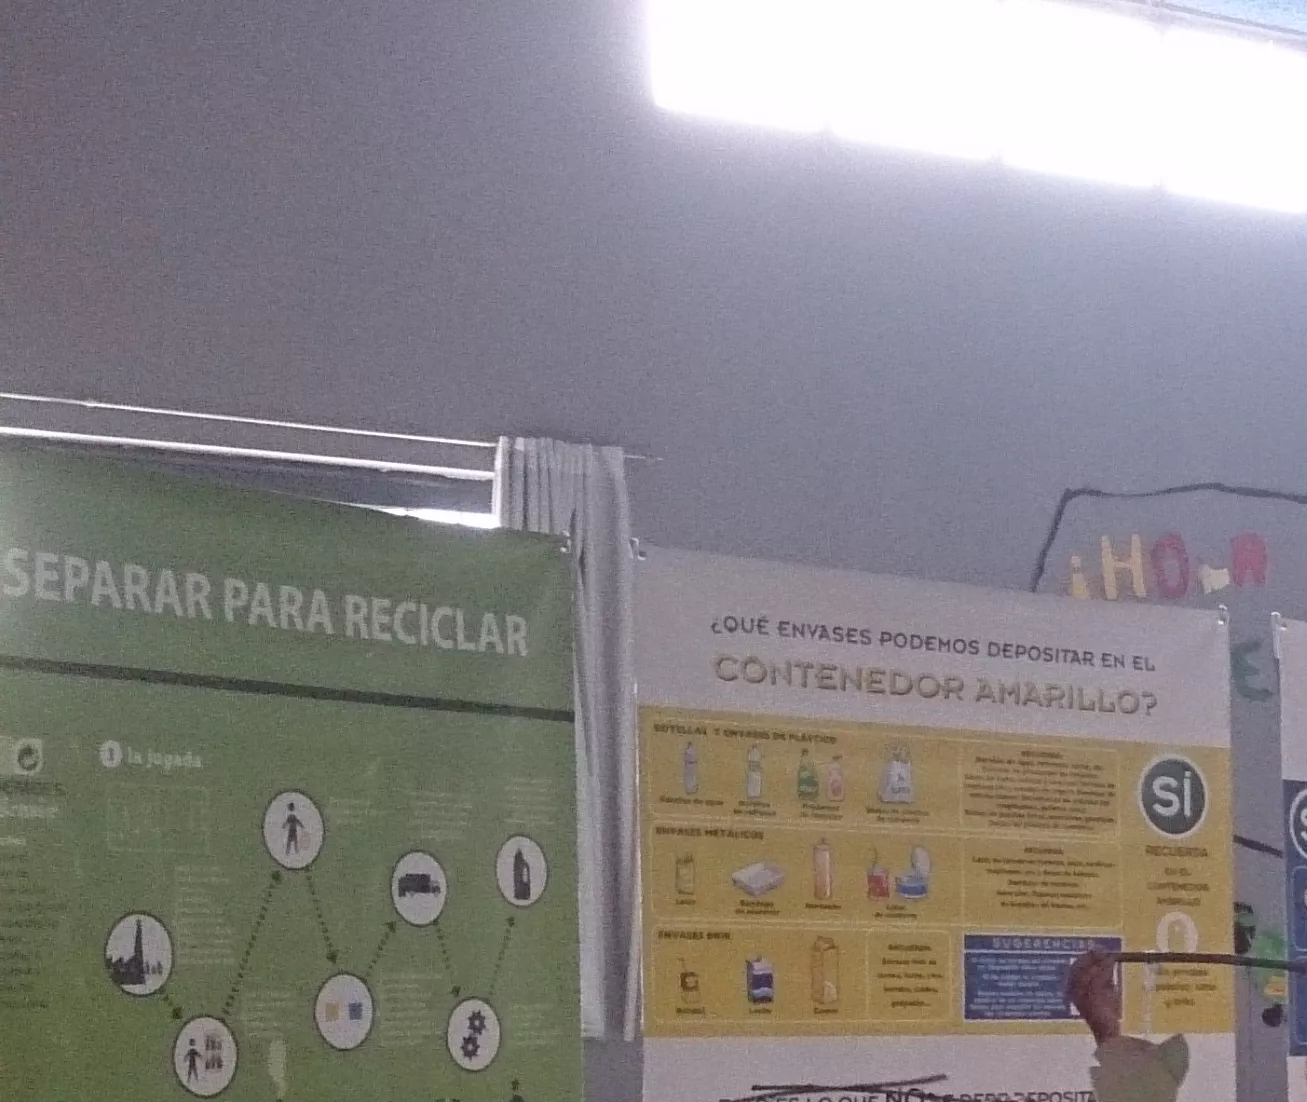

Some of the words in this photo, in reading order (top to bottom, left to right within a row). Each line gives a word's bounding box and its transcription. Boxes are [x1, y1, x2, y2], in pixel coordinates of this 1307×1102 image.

[2, 547, 212, 619] SEPARAR
[223, 578, 335, 636] PARA
[345, 596, 528, 657] RECICLAR
[710, 614, 770, 637] ¿QUÉ
[777, 620, 872, 646] ENVASES
[879, 631, 980, 656] PODEMOS
[987, 641, 1095, 668] DEPOSITAR
[1101, 652, 1126, 670] EN
[1132, 655, 1156, 673] EL
[713, 653, 966, 702] CONTENEDOR
[976, 676, 1158, 717] AMARILLO?
